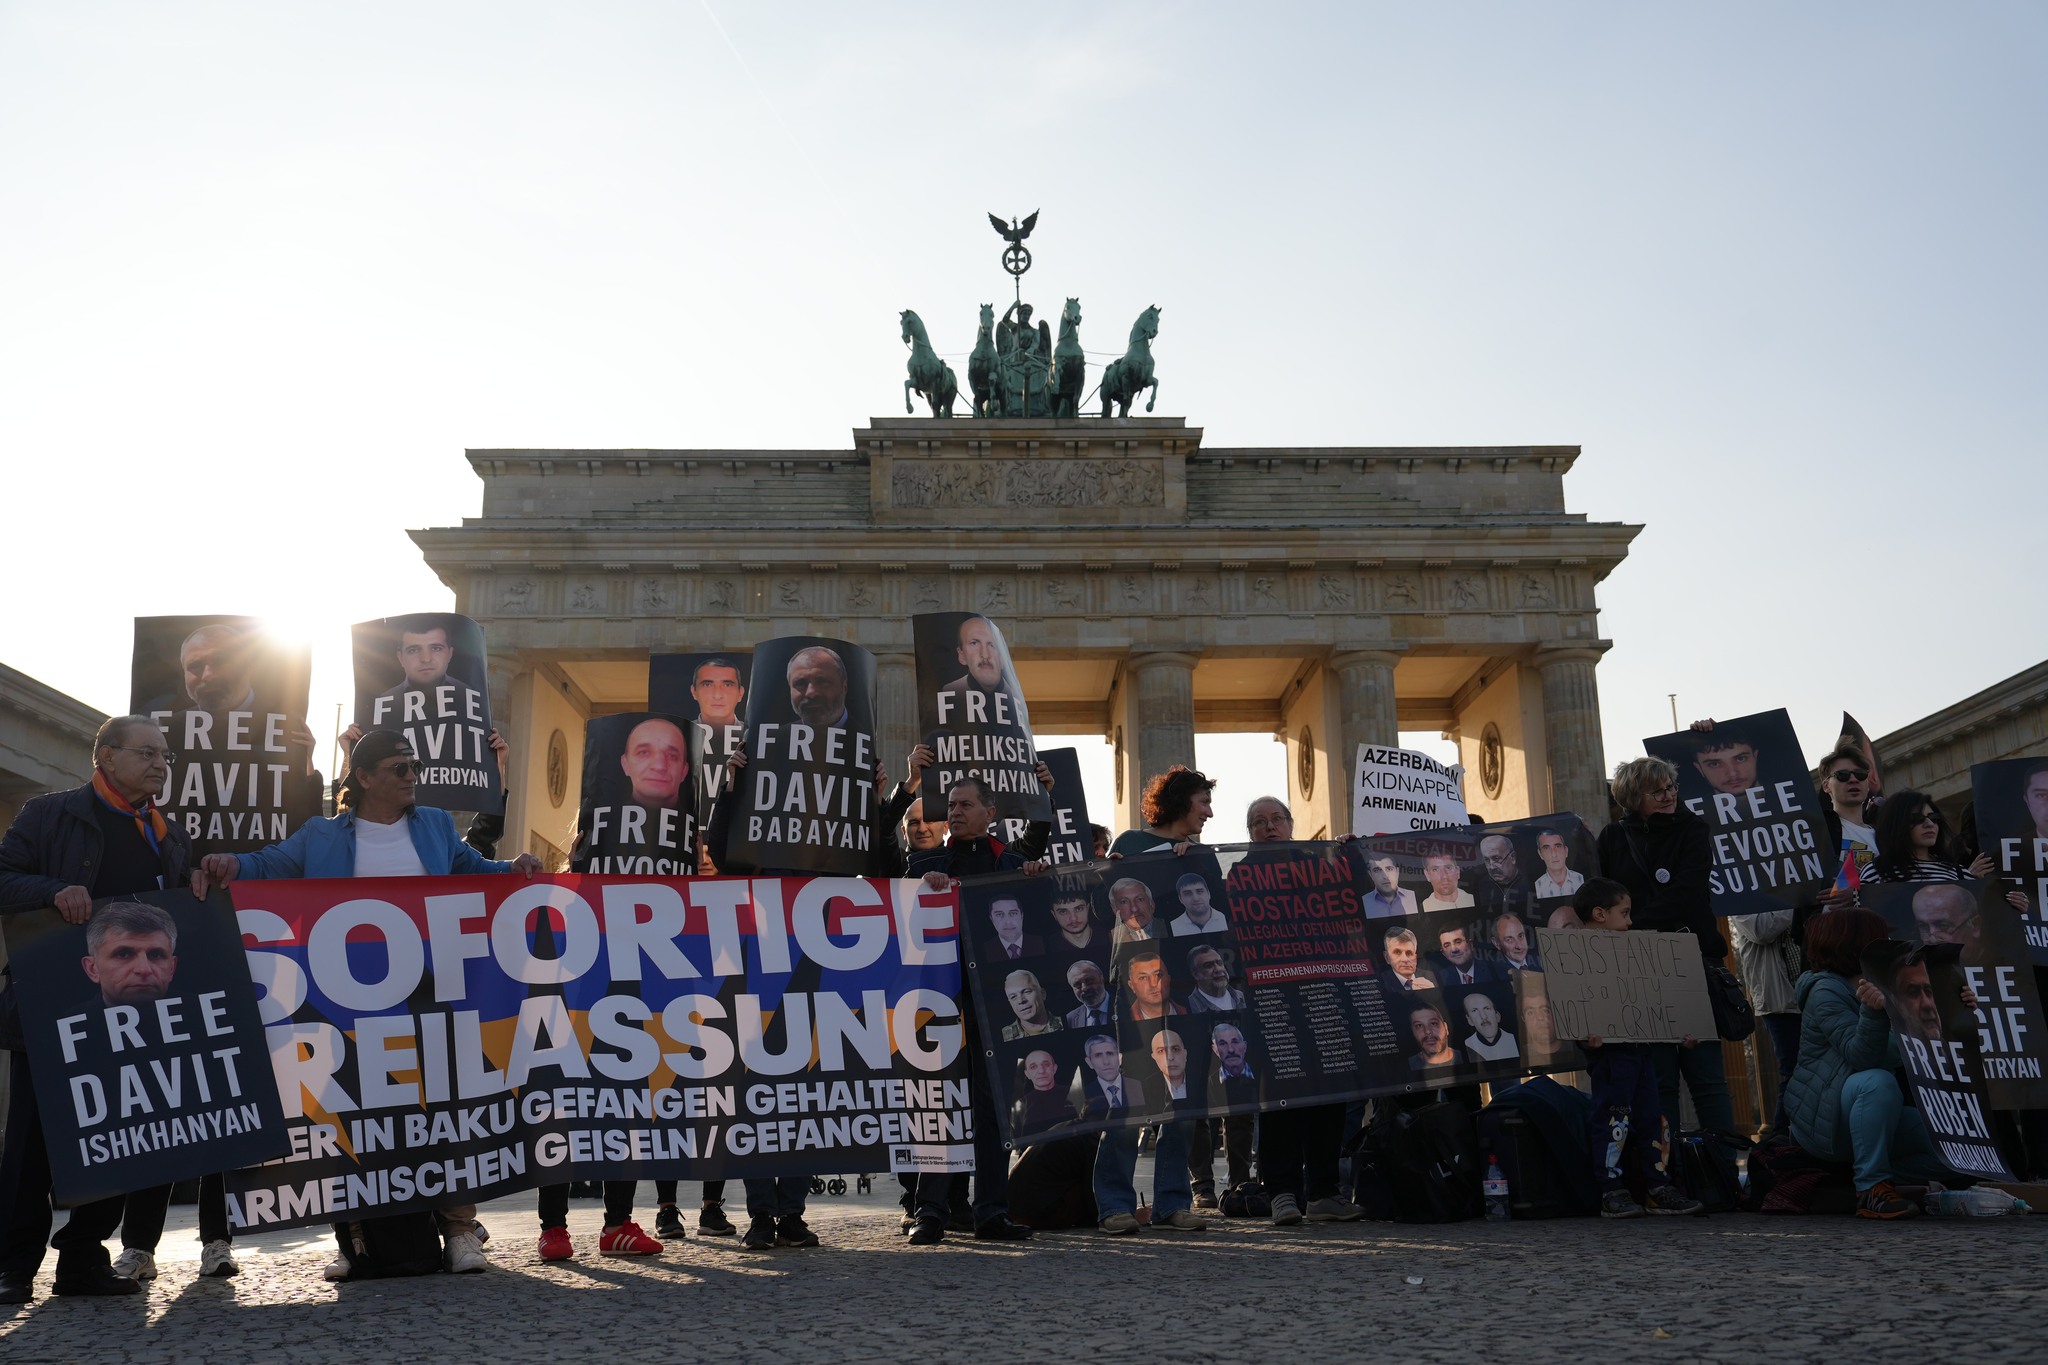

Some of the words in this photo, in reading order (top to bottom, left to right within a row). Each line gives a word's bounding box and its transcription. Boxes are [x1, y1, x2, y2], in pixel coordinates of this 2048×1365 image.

[373, 686, 483, 725] FREE
[937, 690, 1027, 728] FREE
[402, 723, 485, 763] AVIT
[756, 723, 872, 771] FREE
[937, 735, 1036, 766] MELIKSET
[1363, 748, 1459, 785] AZERBAIJAN
[754, 770, 873, 821] DAVIT
[1362, 796, 1436, 815] ARMENIAN
[1684, 780, 1802, 826] FREE
[591, 805, 695, 854] FREE
[748, 815, 870, 852] BABAYAN
[1712, 819, 1815, 866] EVORG
[1226, 856, 1353, 892] ARMENIAN
[1709, 852, 1824, 895] SUJYAN
[1229, 889, 1359, 922] HOSTAGES
[235, 876, 958, 1026] SOFORTIGE
[1235, 921, 1300, 941] ILLEGALLY
[1302, 918, 1363, 937] DETAINED
[1240, 944, 1257, 961] IN
[1263, 938, 1368, 959] AZERBAIDJAN
[1252, 963, 1368, 980] #FREEARMENIANPRISONERS
[1539, 932, 1687, 978] RESISTANCE
[1581, 983, 1595, 1000] is
[1601, 985, 1609, 1000] a
[1616, 976, 1663, 1006] DUTY
[57, 990, 235, 1064] FREE
[1552, 1000, 1591, 1039] NOT
[1608, 1023, 1620, 1038] a
[1621, 1004, 1681, 1040] CRIME
[265, 988, 963, 1120] REILASSUNG
[1900, 1033, 1971, 1084] FREE
[69, 1046, 242, 1128] DAVIT
[350, 1116, 395, 1154] IN
[404, 1098, 516, 1148] BAKU
[521, 1085, 736, 1126] GEFANGEN
[745, 1078, 970, 1116] GEHALTENEN
[1917, 1085, 1990, 1139] RUBEN
[78, 1102, 262, 1167] ISHKHANYAN
[226, 1141, 526, 1229] ARMENISCHEN
[534, 1127, 698, 1168] GEISELN
[725, 1110, 974, 1157] GEFANGENEN!
[1939, 1140, 2006, 1174] VARDANYAN
